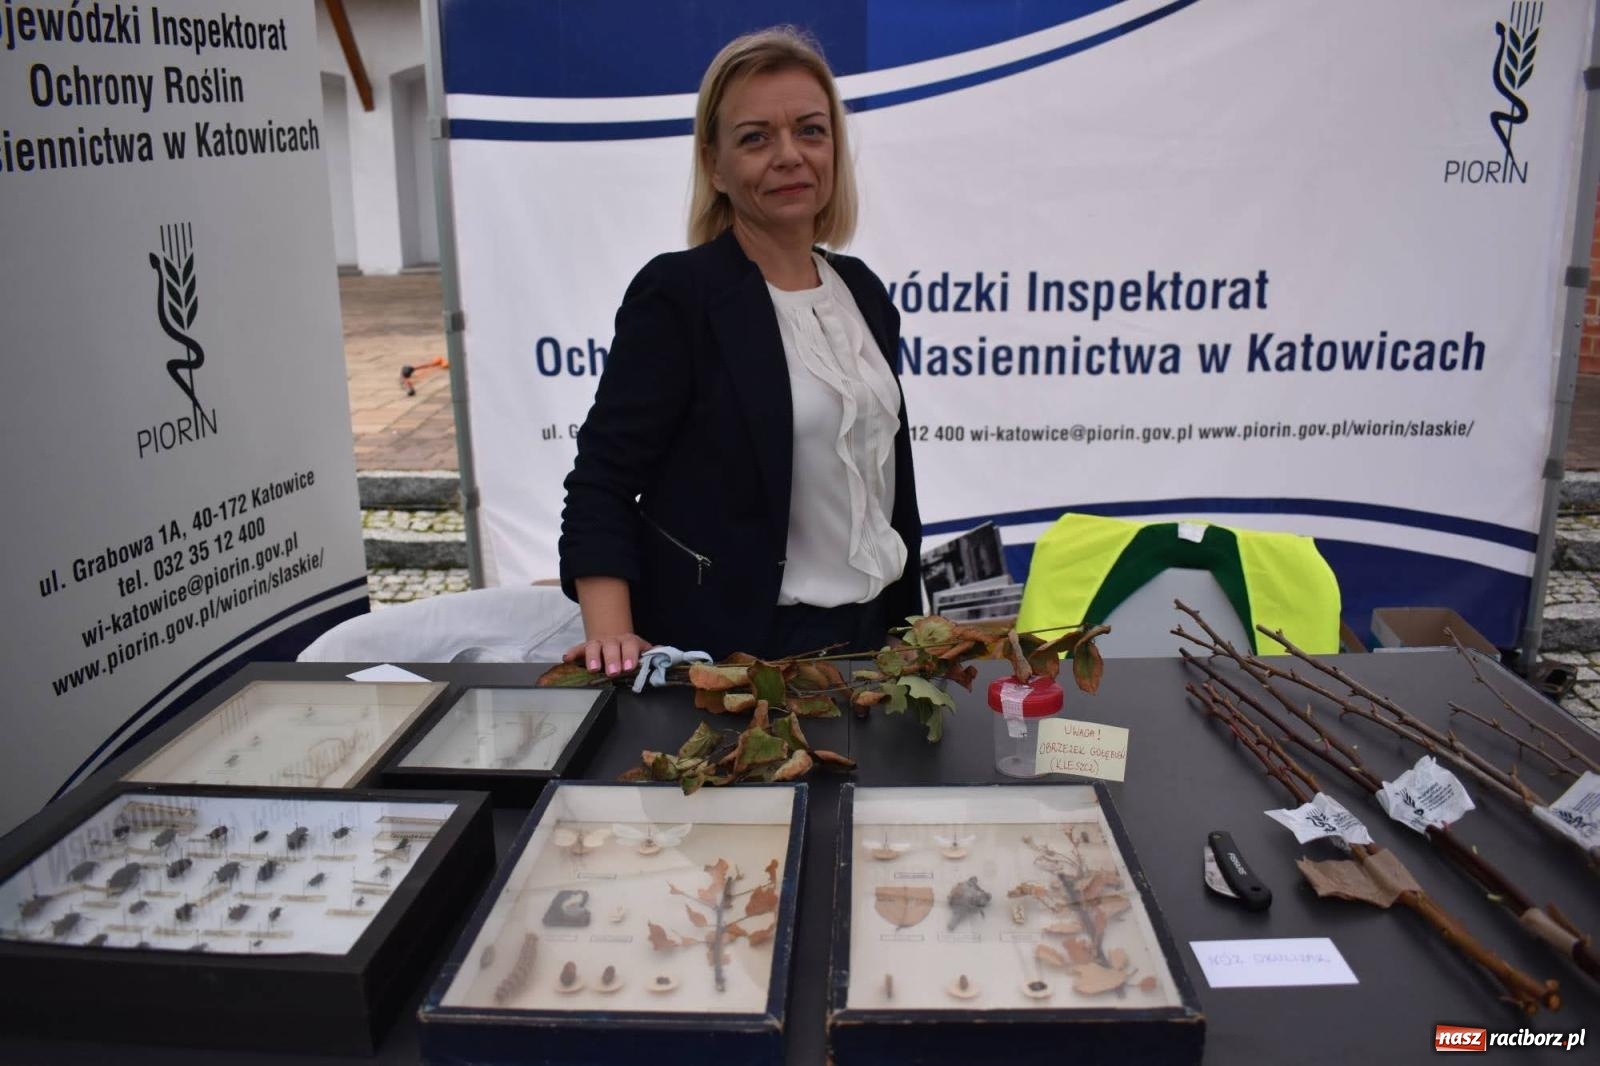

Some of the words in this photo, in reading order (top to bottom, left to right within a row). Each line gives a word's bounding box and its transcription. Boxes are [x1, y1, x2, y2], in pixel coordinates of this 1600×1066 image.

[0, 0, 141, 50] jewódzki
[152, 7, 287, 55] Inspektorat
[31, 63, 153, 113] Ochrony
[164, 66, 244, 104] Roślin
[0, 126, 154, 172] iennictwa
[163, 131, 186, 160] w
[195, 118, 320, 159] Katowicach
[1444, 160, 1528, 184] PIORIN
[1027, 270, 1269, 321] Inspektorat
[897, 336, 1181, 376] Nasiennictwa
[1198, 343, 1231, 374] w
[1247, 331, 1486, 374] Katowicach
[137, 408, 218, 459] PIORIN
[542, 423, 563, 441] ul.
[910, 425, 929, 442] 12
[934, 425, 965, 442] 400
[970, 424, 1193, 445] wi-katowice@piorin.gov.pl
[1198, 420, 1475, 442] www.piorin.gov.pl/wiorin/slaskie/
[39, 571, 67, 598] ul.
[72, 535, 155, 584] Grabowa
[159, 519, 188, 546] 1A,
[192, 494, 248, 533] 40-172
[251, 470, 315, 508] Katowice
[118, 574, 149, 598] tel.
[153, 551, 184, 582] 032
[189, 540, 210, 566] 35
[216, 529, 234, 553] 12
[238, 516, 266, 545] 400
[81, 531, 299, 648] wi-katowice@piorin.gov.pl
[52, 547, 325, 697] www.piorin.gov.pl/wiorin/slaskie/
